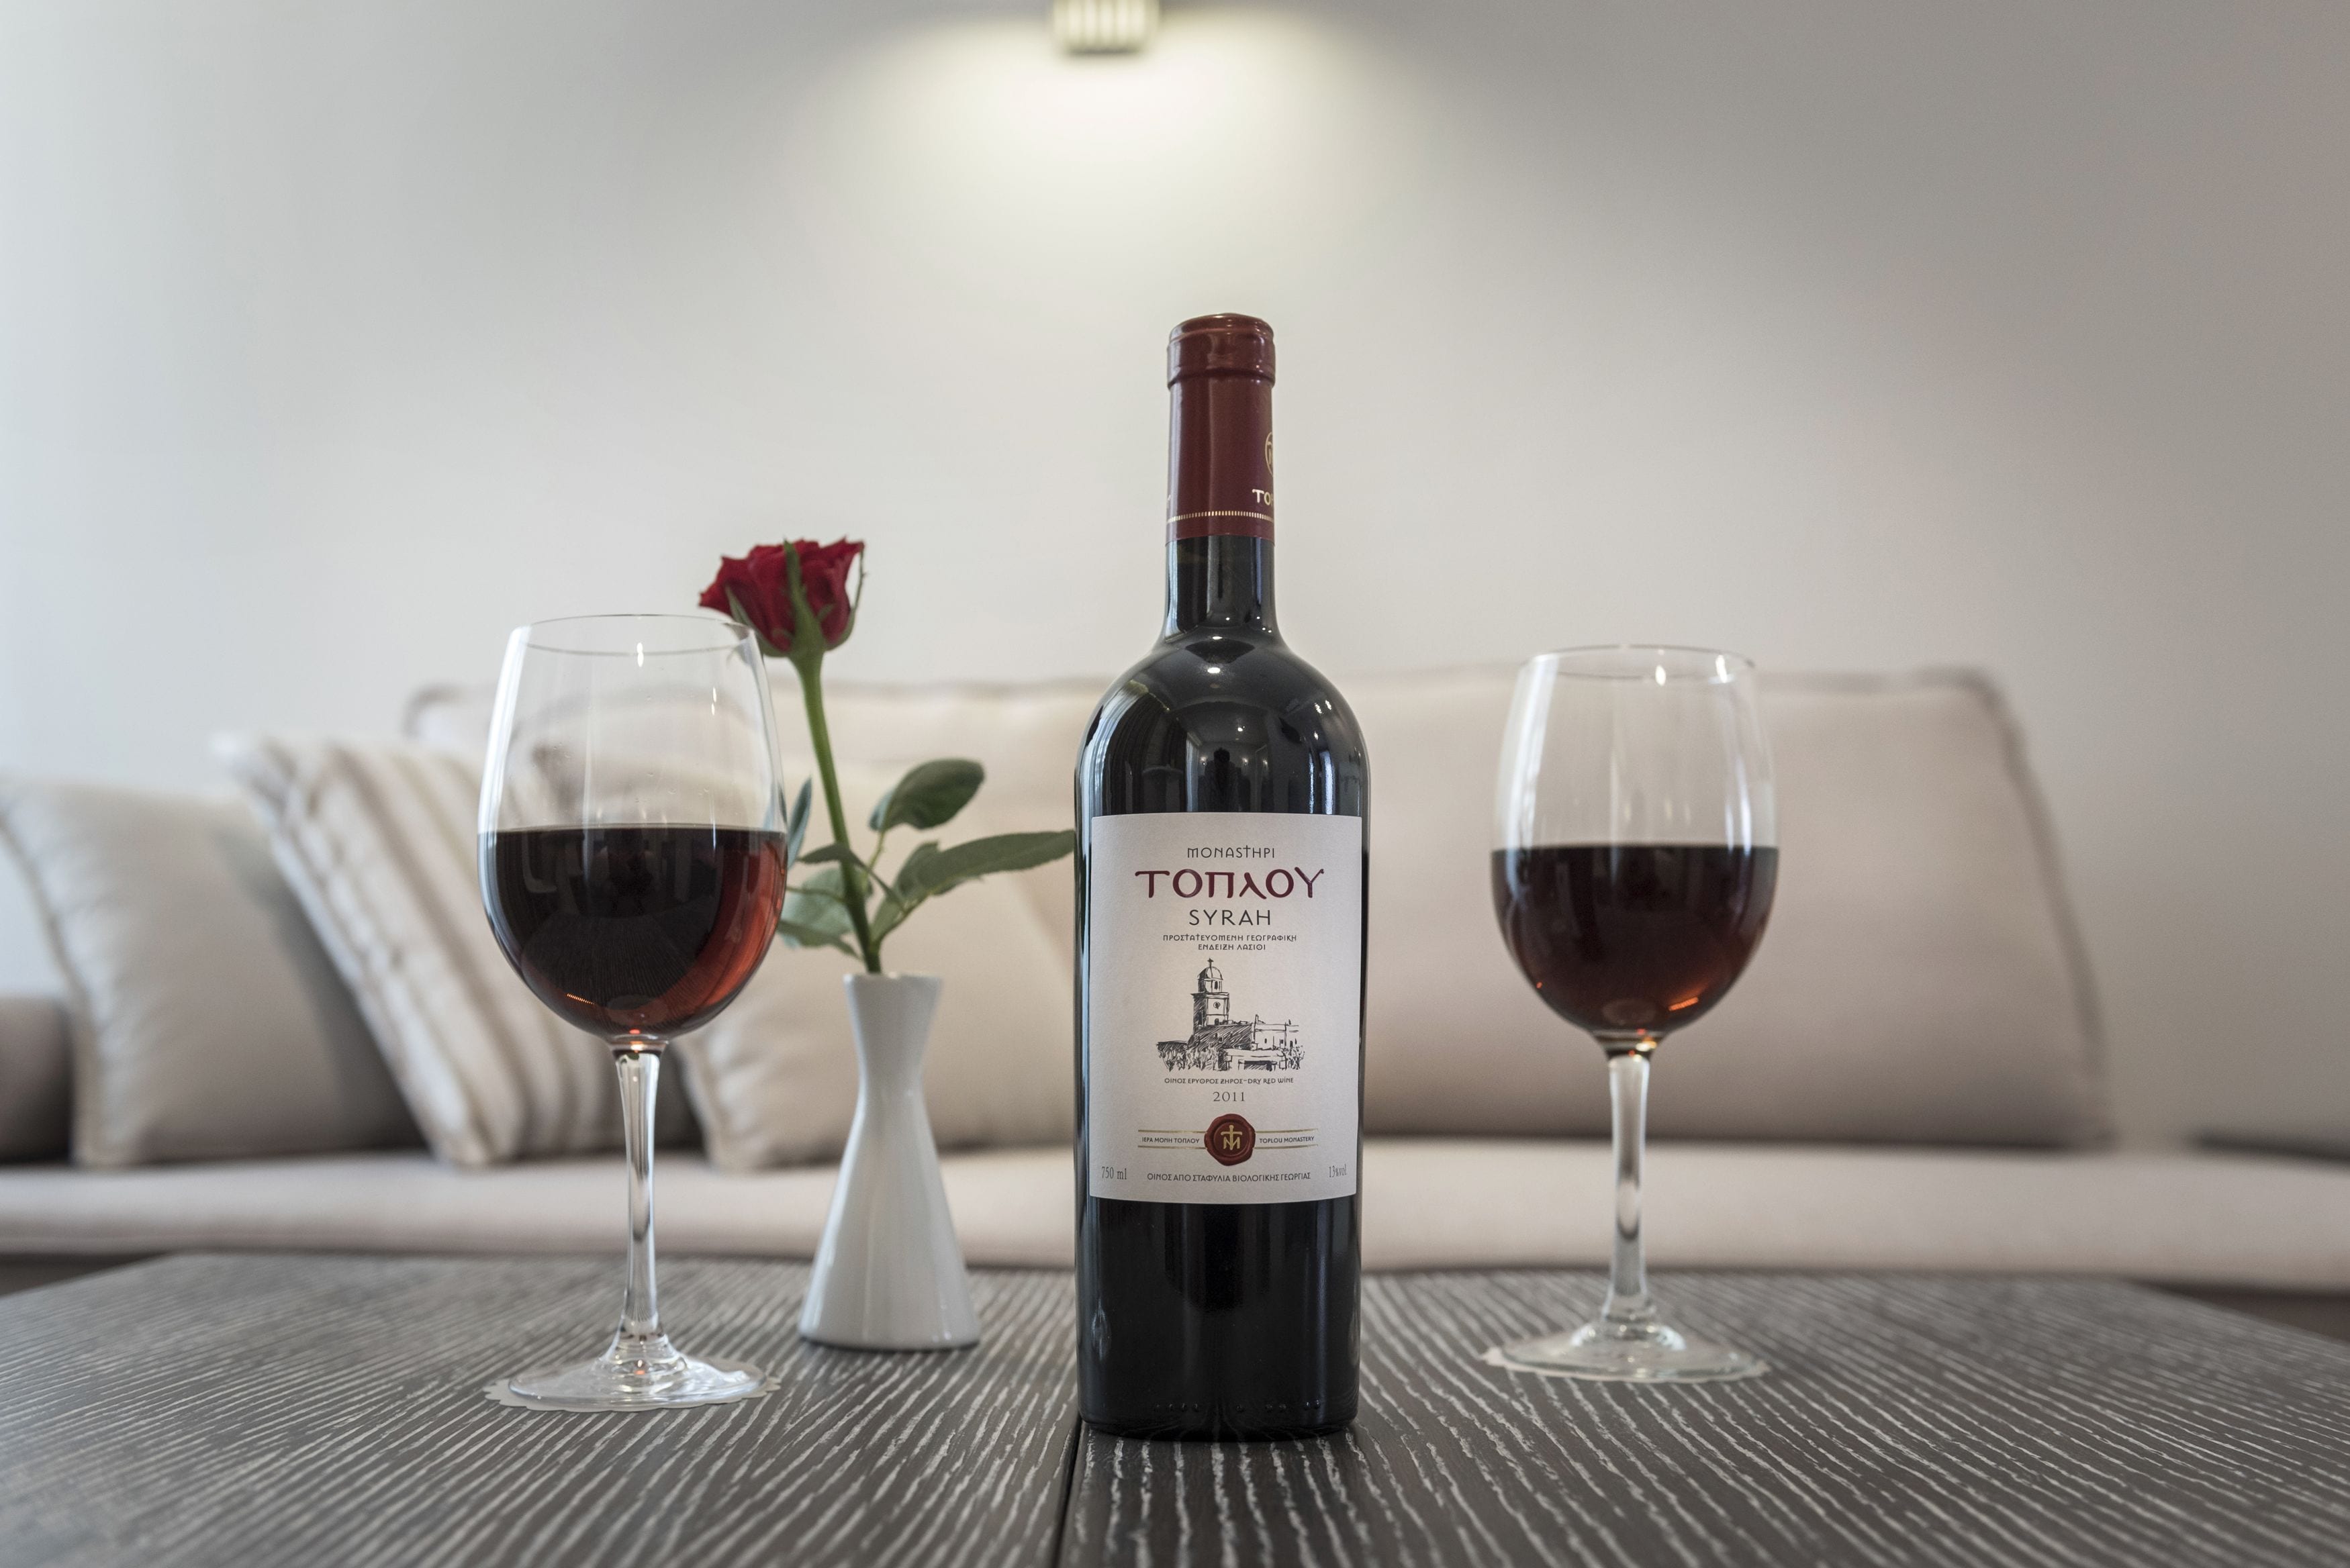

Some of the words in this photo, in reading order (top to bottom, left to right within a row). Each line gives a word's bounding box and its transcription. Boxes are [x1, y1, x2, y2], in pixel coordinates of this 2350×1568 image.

[1188, 910, 1271, 926] SYRAH
[1213, 1091, 1246, 1102] 2011
[1101, 1166, 1114, 1179] 750
[1117, 1168, 1127, 1180] ml
